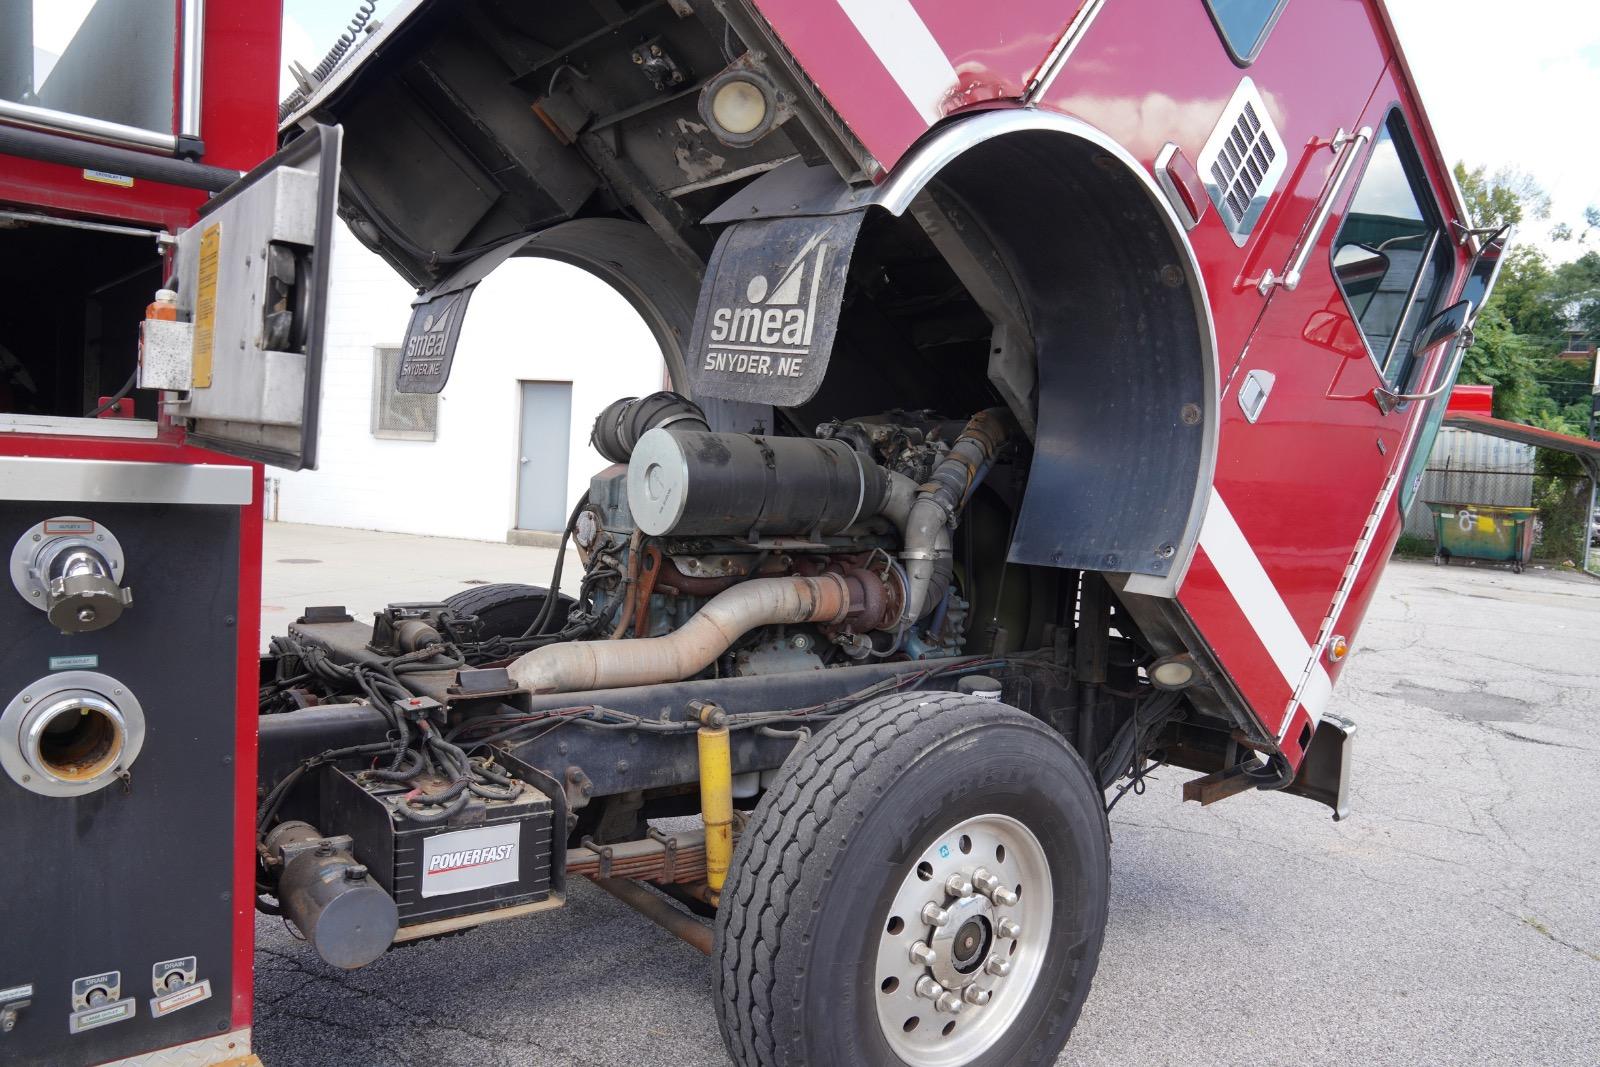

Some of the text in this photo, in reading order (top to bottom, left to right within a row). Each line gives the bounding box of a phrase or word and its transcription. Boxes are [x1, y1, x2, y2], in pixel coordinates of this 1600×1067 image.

[704, 352, 773, 377] SNYDER,
[429, 844, 515, 871] POWERFAST
[164, 961, 185, 969] DRAIN
[86, 976, 107, 985] DRAIN
